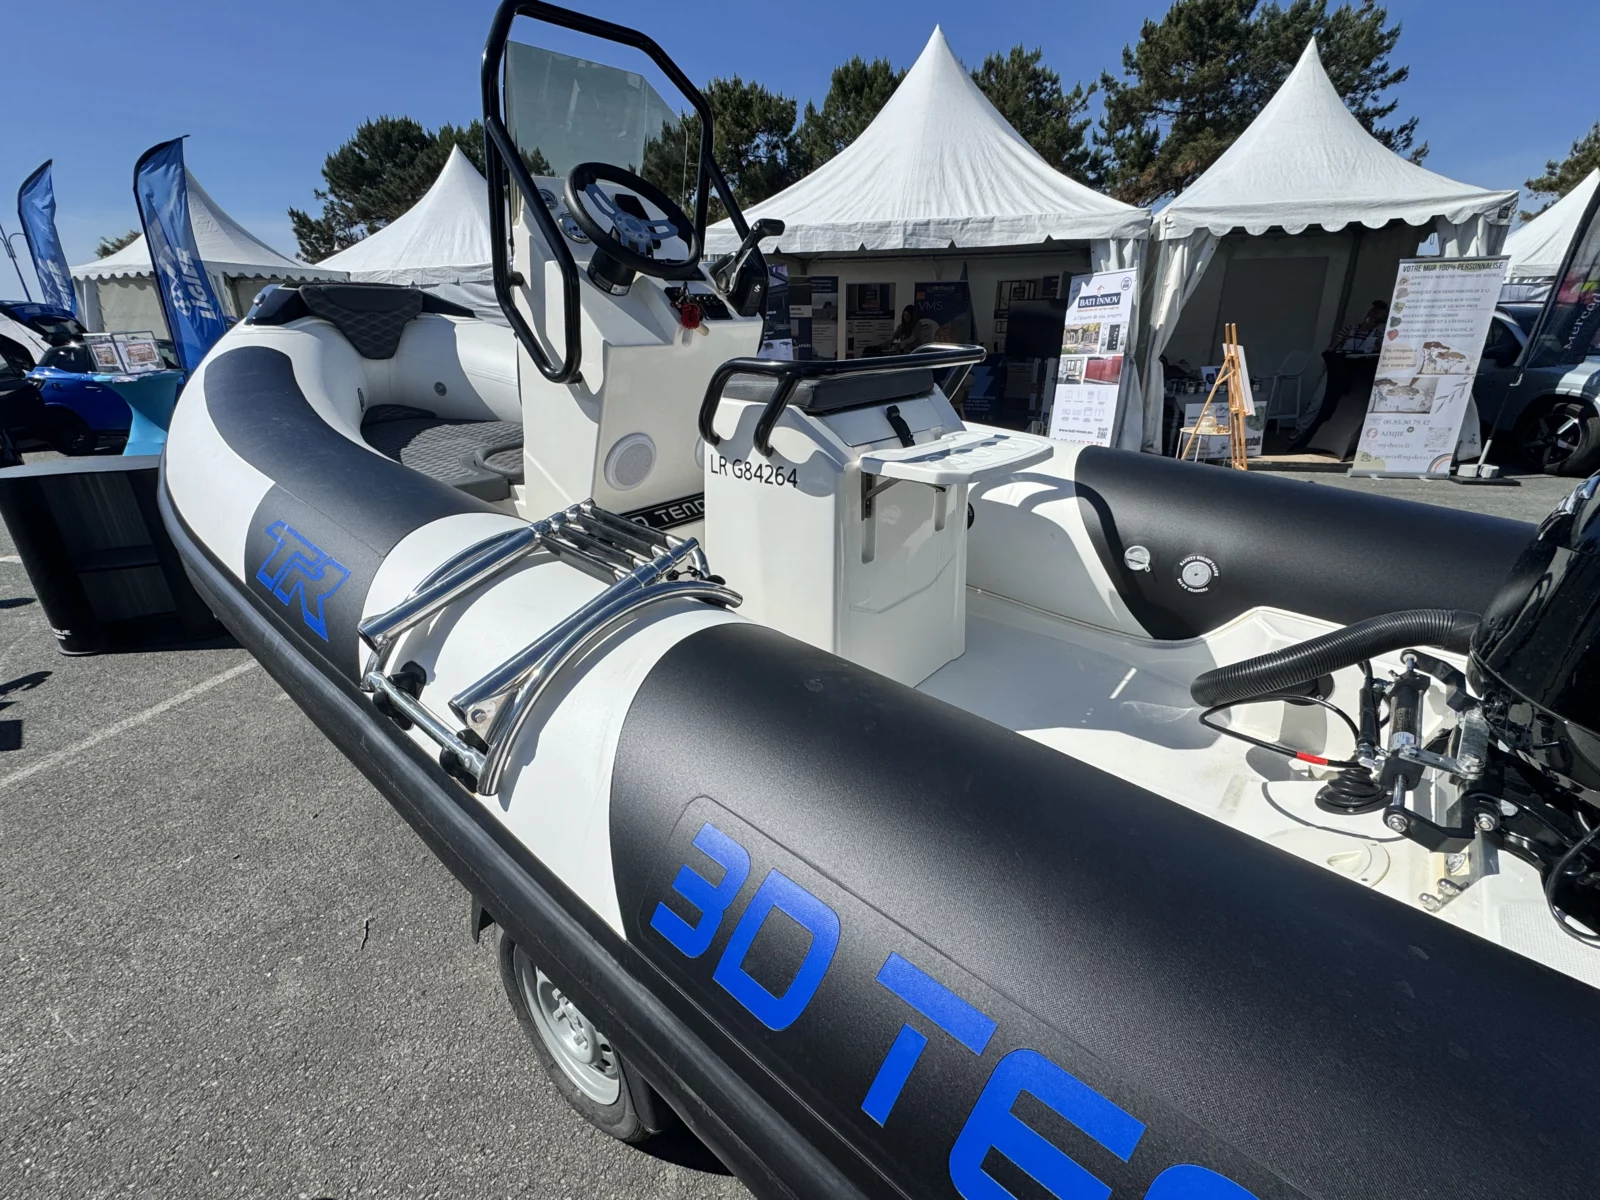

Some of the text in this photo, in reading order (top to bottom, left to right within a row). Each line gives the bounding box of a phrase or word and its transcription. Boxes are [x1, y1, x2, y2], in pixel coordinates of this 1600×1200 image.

[176, 247, 217, 320] LIGIER
[918, 300, 943, 311] VMS
[1080, 296, 1120, 306] BATI INNOV
[710, 454, 798, 488] LR G84264
[264, 519, 351, 642] TR
[650, 821, 1260, 1200] 3D TE
